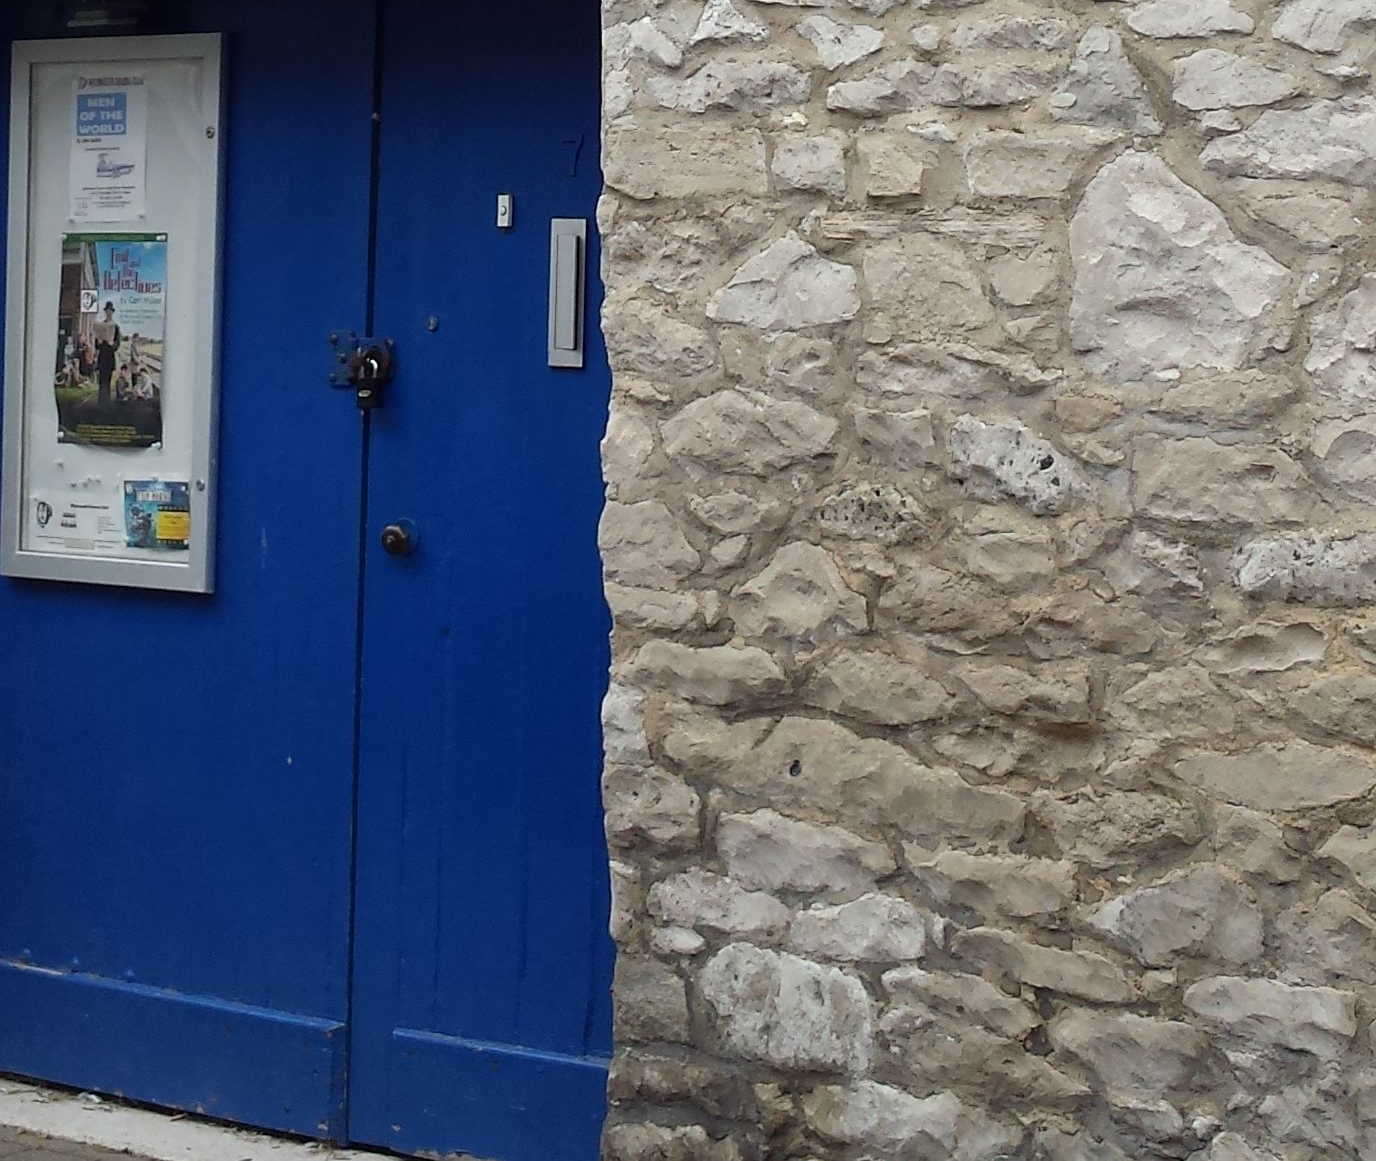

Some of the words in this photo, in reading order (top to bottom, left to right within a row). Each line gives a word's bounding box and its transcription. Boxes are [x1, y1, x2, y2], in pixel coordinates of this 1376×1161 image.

[87, 97, 116, 107] MEN
[79, 111, 97, 121] OF
[100, 110, 124, 120] THE
[79, 123, 125, 134] WORLD
